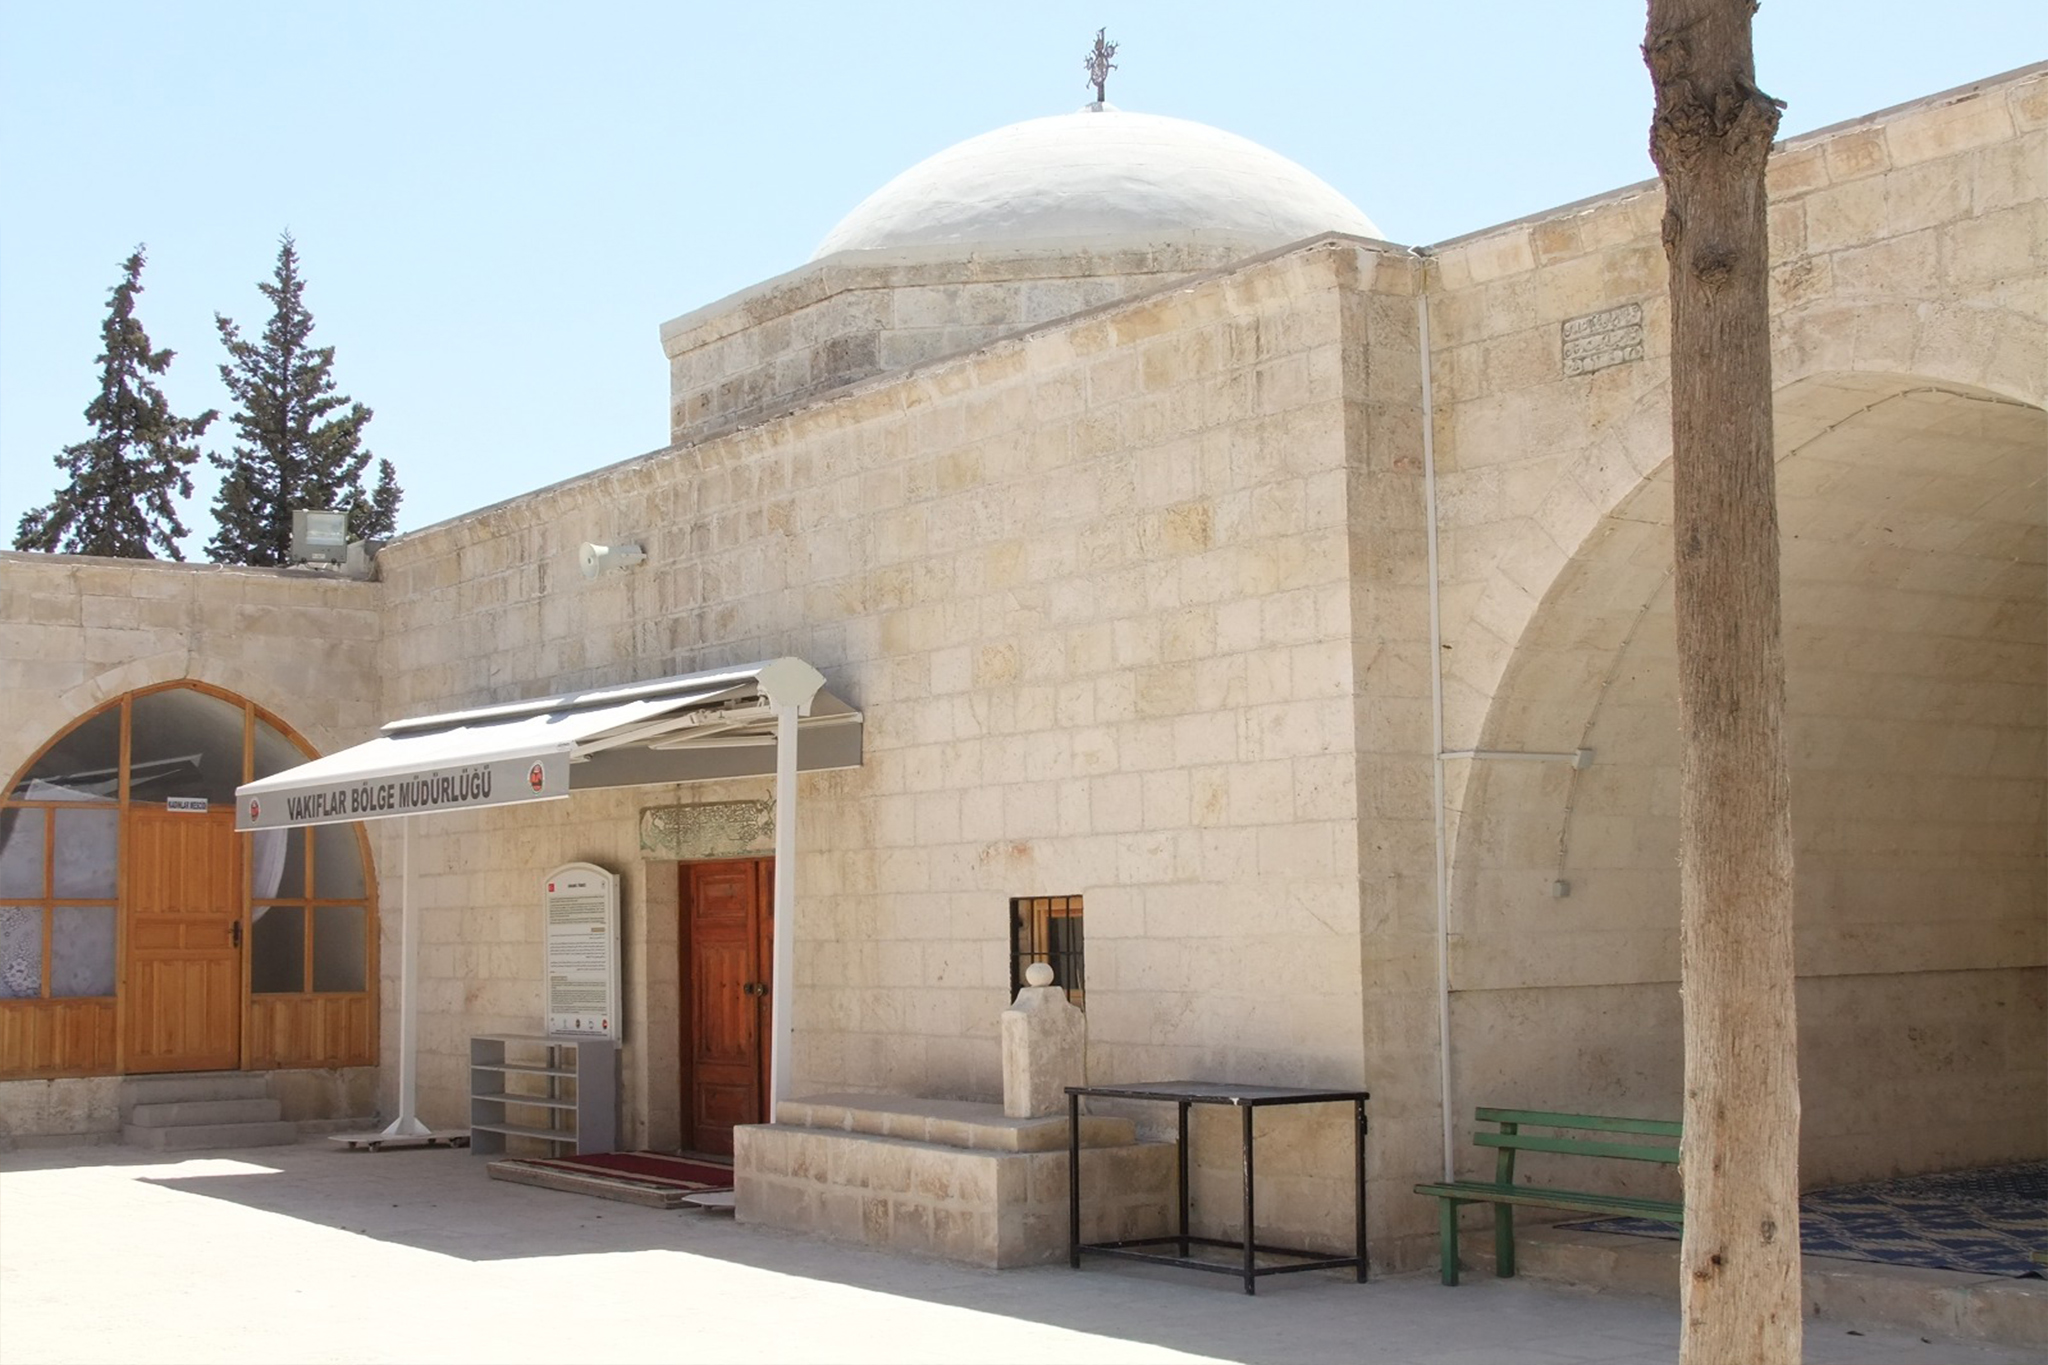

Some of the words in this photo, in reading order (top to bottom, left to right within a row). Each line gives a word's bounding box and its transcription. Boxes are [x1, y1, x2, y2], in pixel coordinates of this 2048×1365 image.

[287, 790, 347, 820] VAKIFLAR
[351, 781, 395, 813] BÖLGE
[399, 764, 492, 808] MÜDÜRLÜĞÜ
